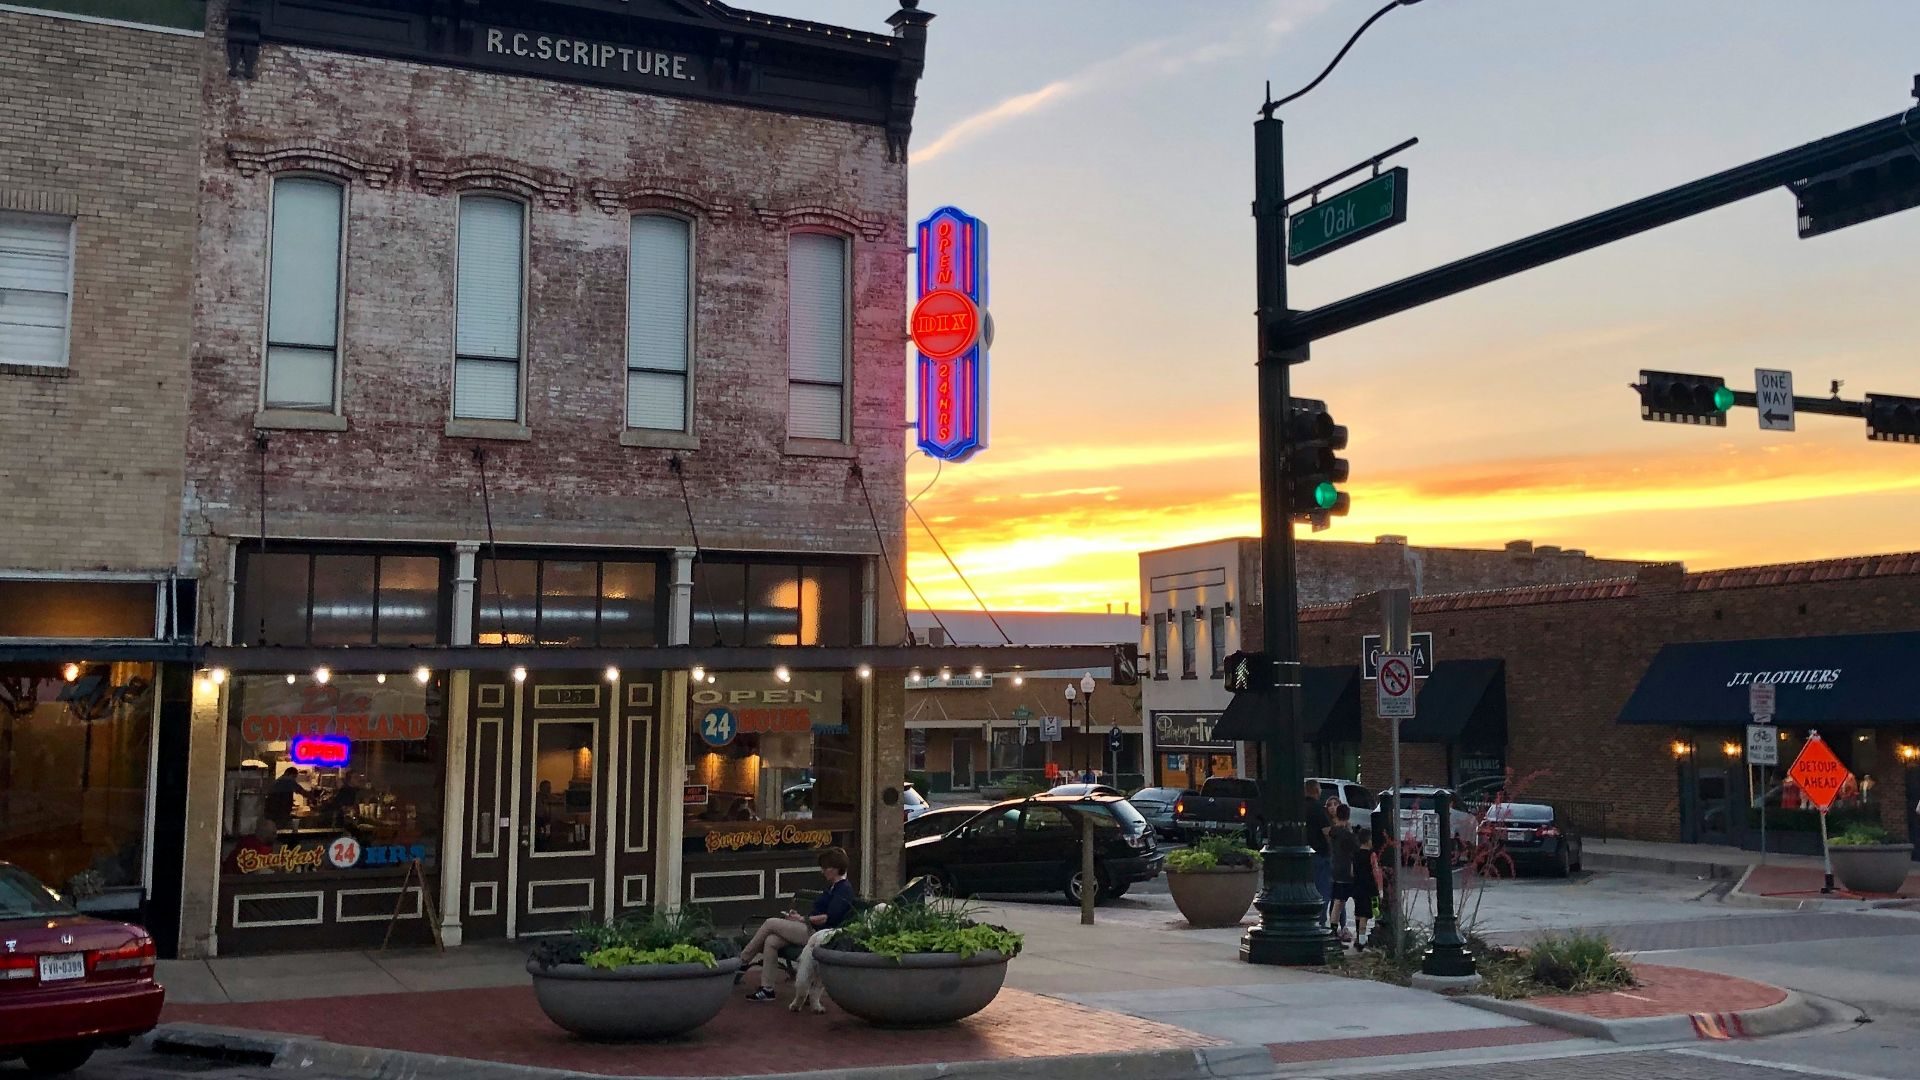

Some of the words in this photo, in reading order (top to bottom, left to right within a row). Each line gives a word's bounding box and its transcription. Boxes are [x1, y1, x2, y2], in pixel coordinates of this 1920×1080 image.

[1324, 199, 1356, 238] Oak
[939, 222, 951, 283] OPEN
[917, 313, 968, 333] DIX
[1762, 374, 1787, 389] ONE
[1763, 391, 1788, 406] WAY
[1726, 672, 1752, 687] J.T.
[1753, 669, 1842, 685] CLOTHIERS
[692, 689, 823, 703] OPEN
[242, 714, 332, 744] CONEY
[335, 713, 430, 741] ISLAND
[705, 712, 731, 740] 24
[738, 708, 812, 733] HOURS
[296, 741, 347, 761] OPEN
[1800, 760, 1837, 772] DETOUR
[1804, 777, 1838, 789] AHEAD
[705, 831, 762, 853] Burgers
[763, 825, 780, 845] &
[237, 844, 325, 874] Breakfast
[334, 843, 356, 863] 24
[366, 843, 426, 864] HRS
